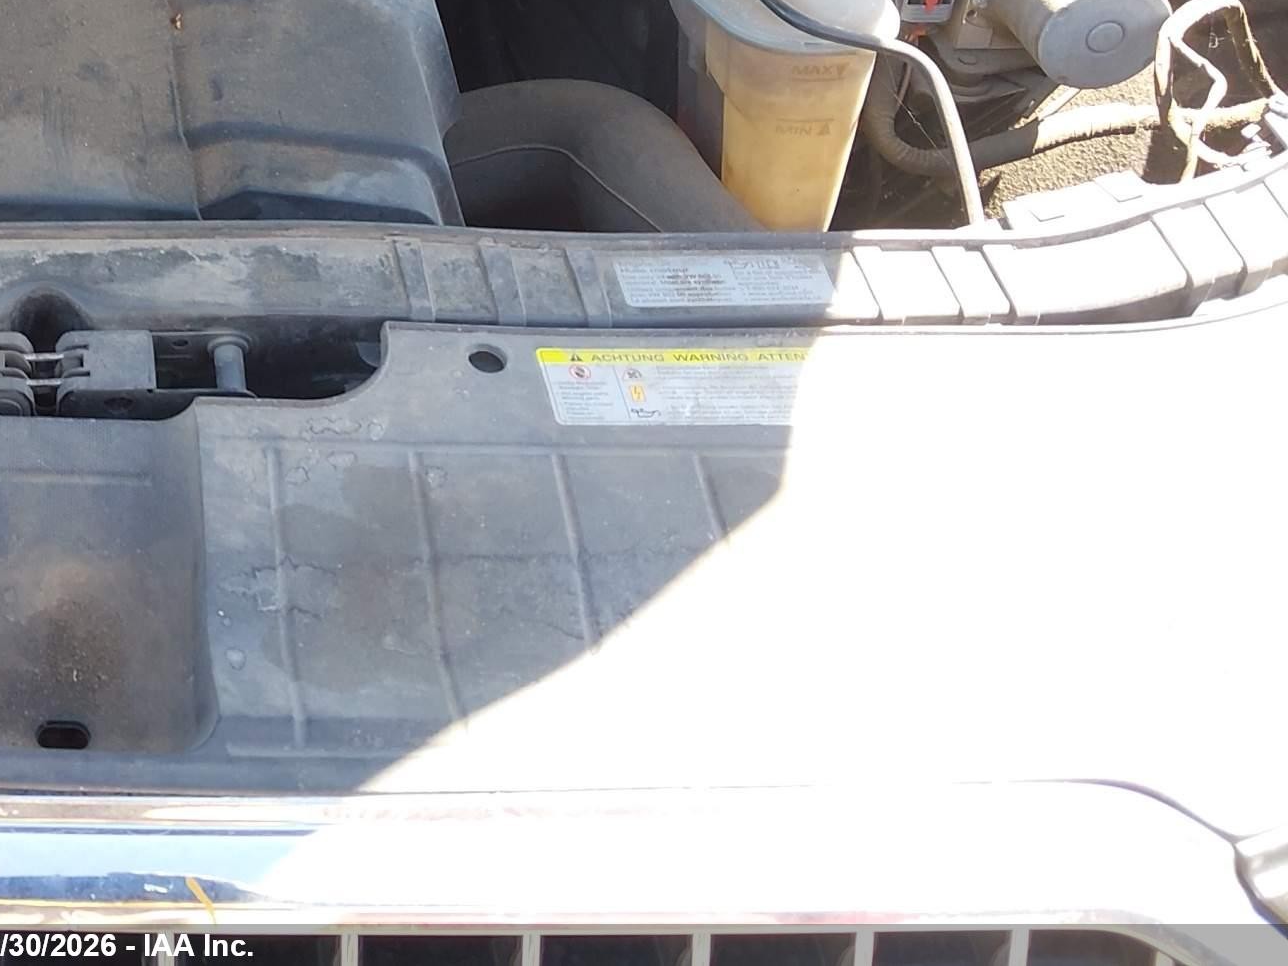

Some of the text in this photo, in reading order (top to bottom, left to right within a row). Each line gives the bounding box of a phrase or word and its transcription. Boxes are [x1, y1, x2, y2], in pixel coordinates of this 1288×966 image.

[791, 64, 833, 75] MAX
[775, 123, 813, 136] MIN
[591, 352, 807, 363] ACHTUNG WARNING ATTEN
